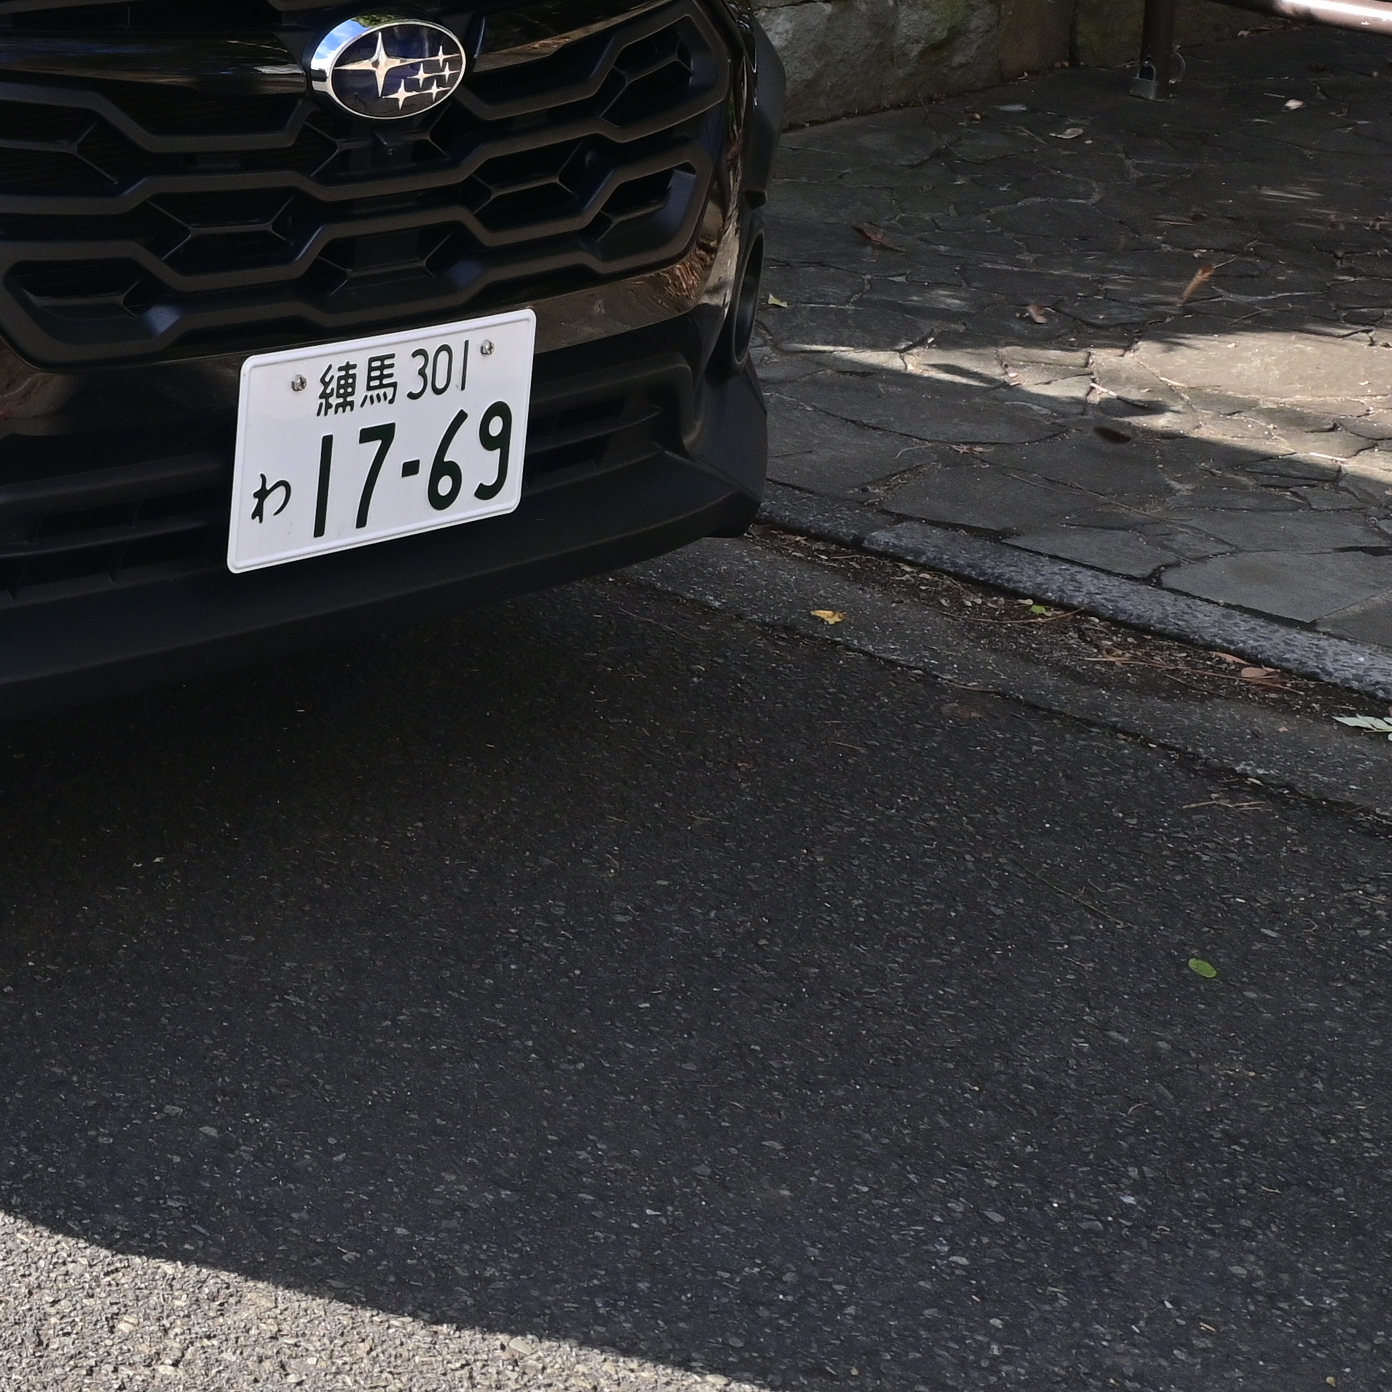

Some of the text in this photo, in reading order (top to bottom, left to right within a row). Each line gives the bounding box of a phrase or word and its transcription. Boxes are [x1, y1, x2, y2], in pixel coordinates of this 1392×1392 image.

[316, 339, 470, 417] 練馬 301
[250, 400, 514, 539] わ 17-69
